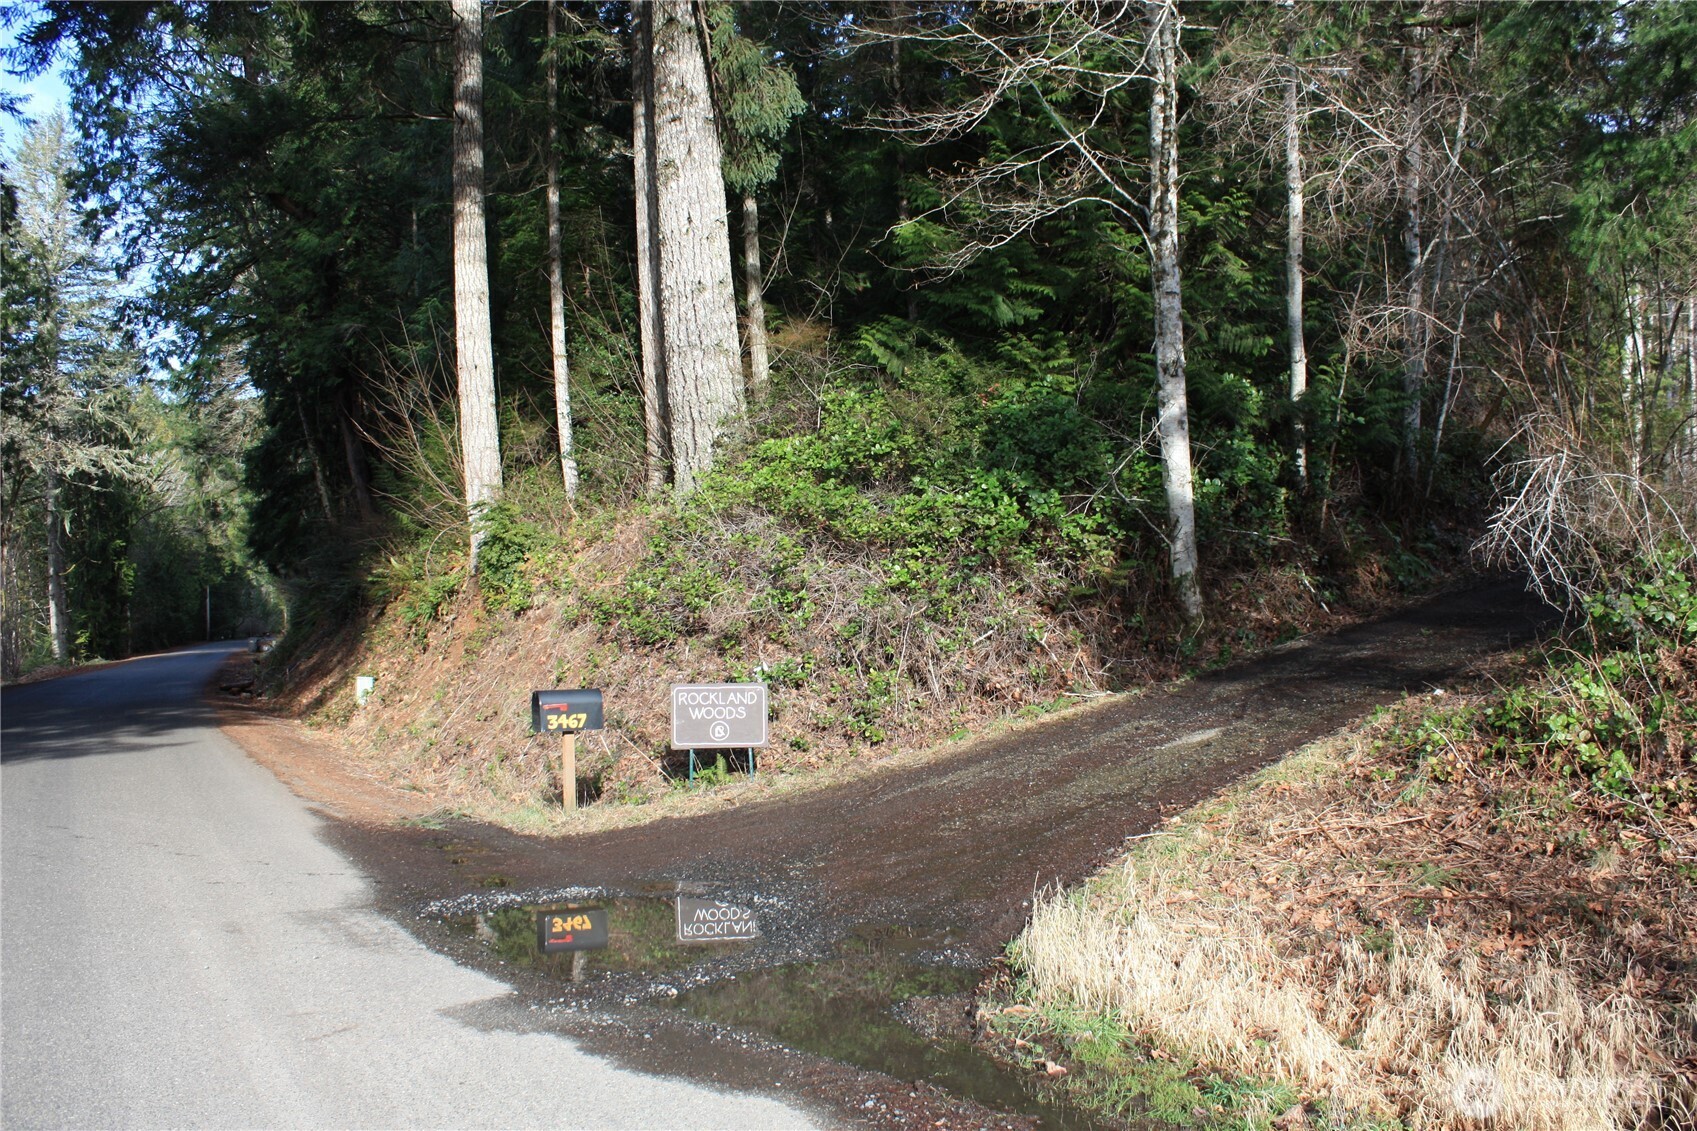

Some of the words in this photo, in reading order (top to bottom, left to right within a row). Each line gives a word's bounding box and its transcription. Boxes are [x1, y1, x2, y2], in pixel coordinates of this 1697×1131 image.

[678, 691, 758, 706] ROCKLAND
[688, 706, 747, 720] WOODS
[546, 713, 588, 730] 3467
